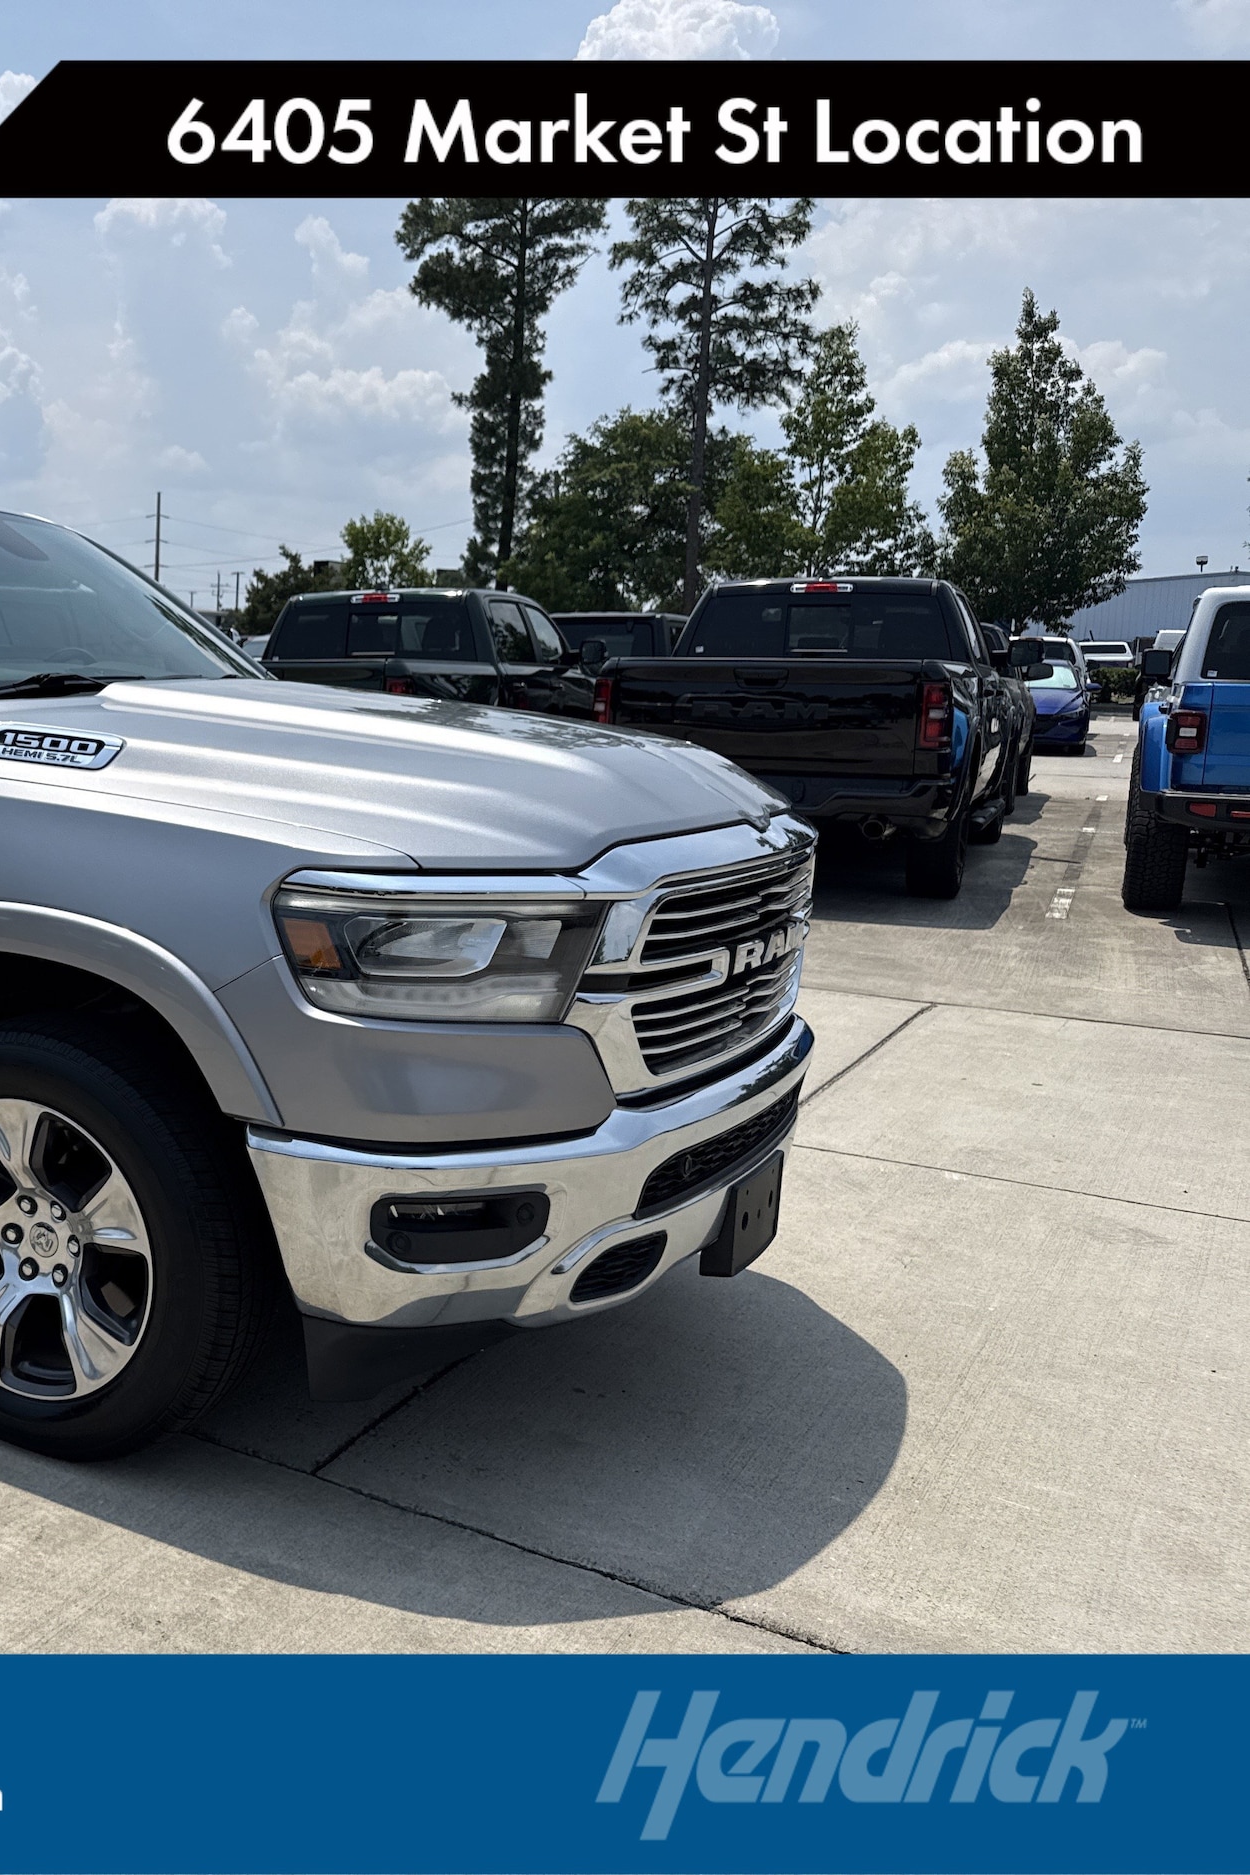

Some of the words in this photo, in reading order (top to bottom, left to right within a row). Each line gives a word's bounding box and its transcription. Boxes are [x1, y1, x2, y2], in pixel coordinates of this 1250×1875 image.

[691, 701, 829, 721] RAM
[3, 732, 98, 755] 1500
[1, 747, 43, 760] HEMI
[46, 753, 81, 763] 5.7L
